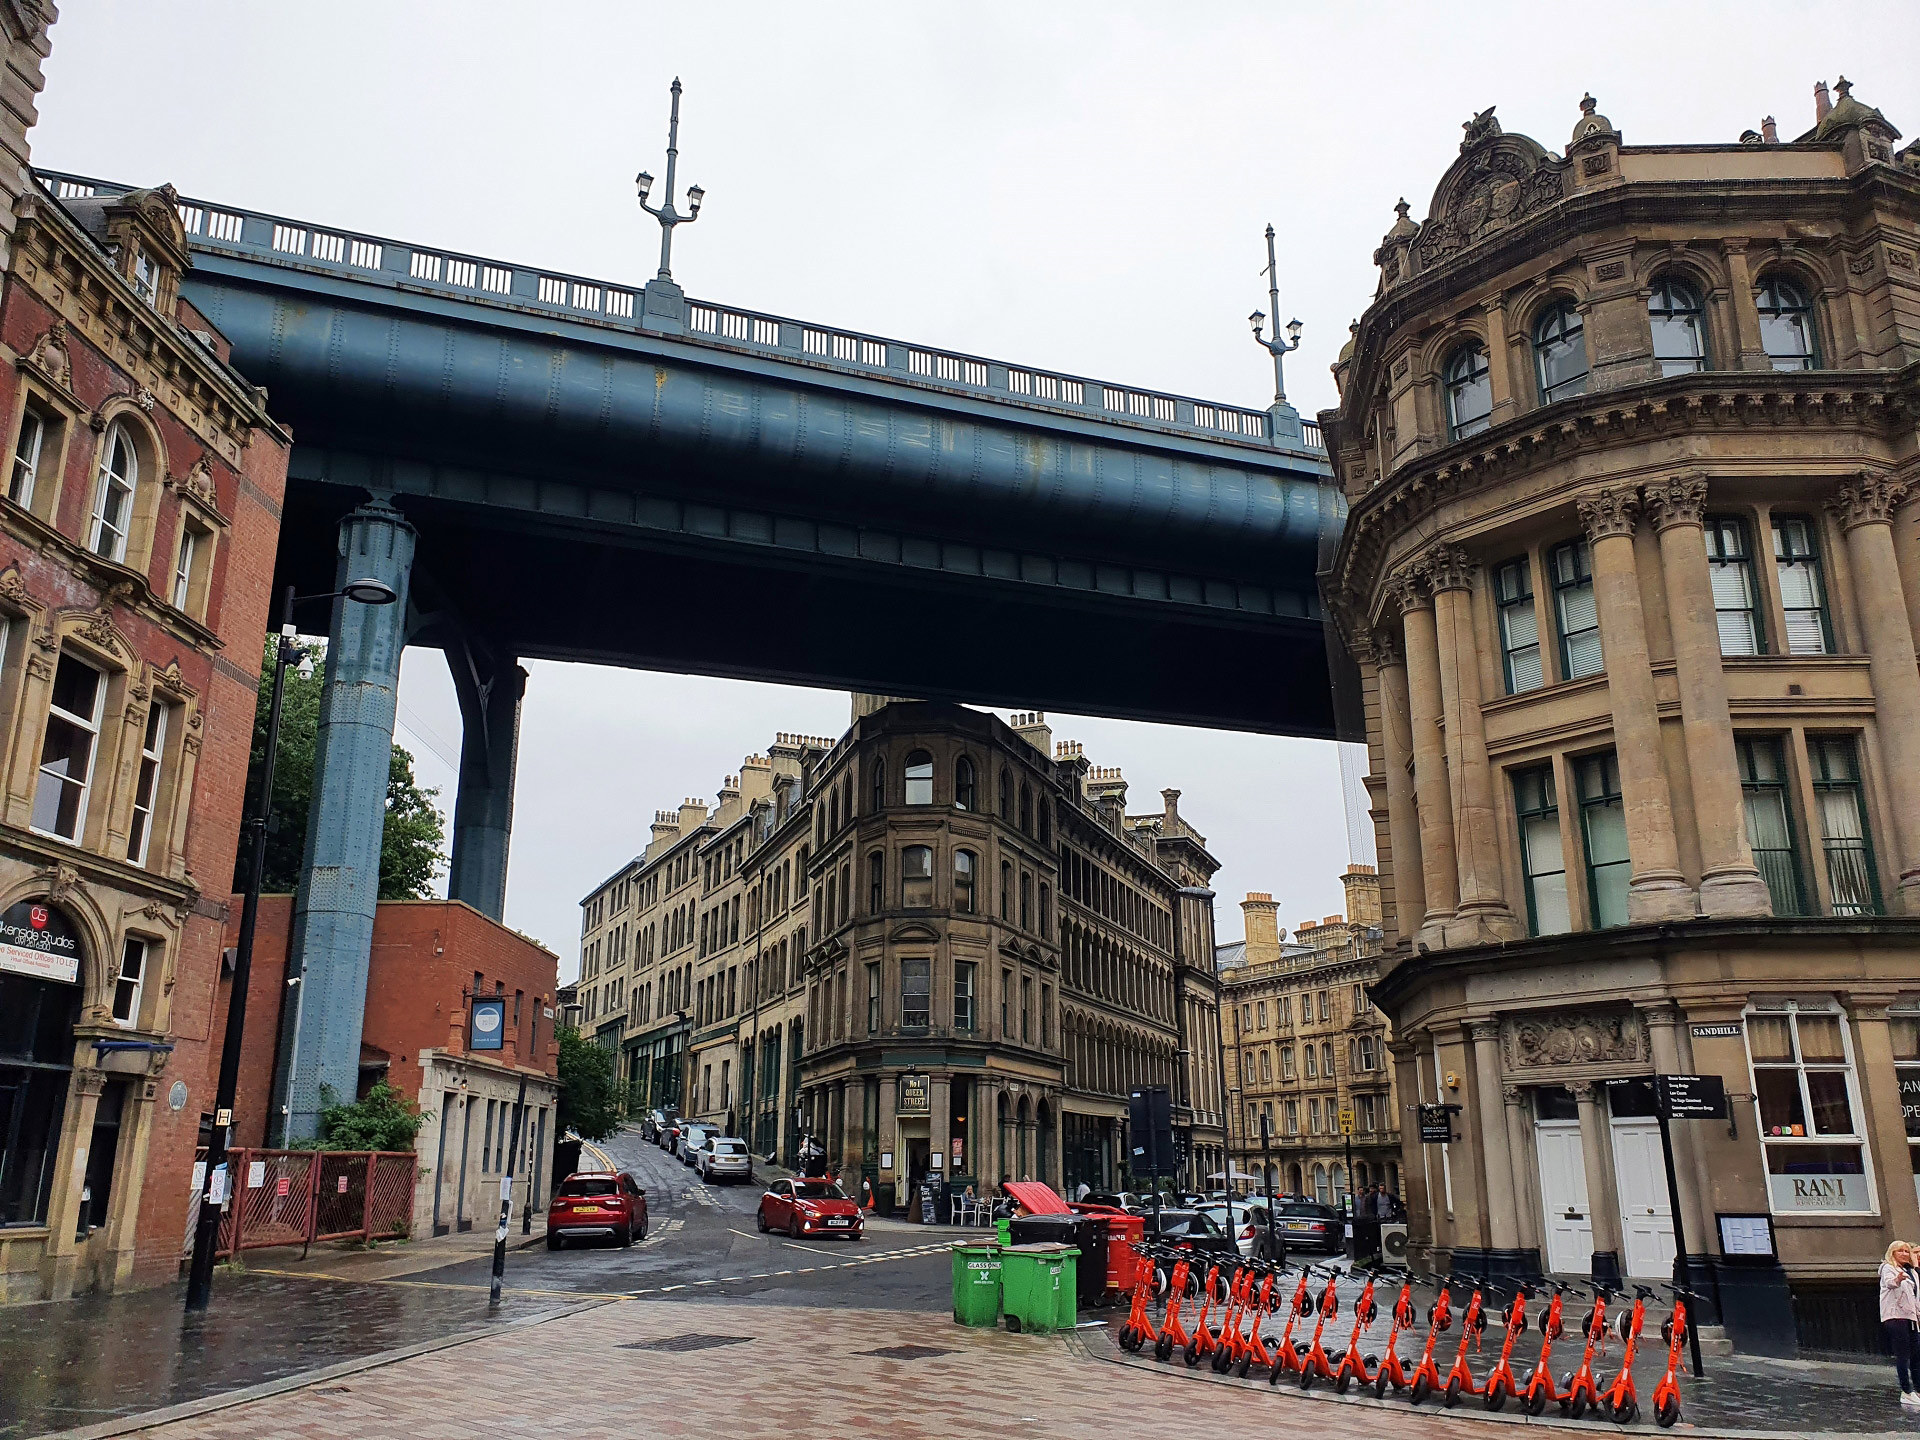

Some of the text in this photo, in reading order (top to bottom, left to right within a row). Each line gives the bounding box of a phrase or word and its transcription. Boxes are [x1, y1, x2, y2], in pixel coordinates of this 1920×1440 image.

[0, 920, 75, 949] kenside Studios
[7, 946, 33, 959] Serviced
[34, 952, 55, 964] Offices
[56, 957, 65, 966] TO
[65, 958, 78, 968] LET
[904, 1097, 925, 1106] STREET
[905, 1089, 924, 1097] QUEEN
[1792, 1178, 1846, 1197] RANI
